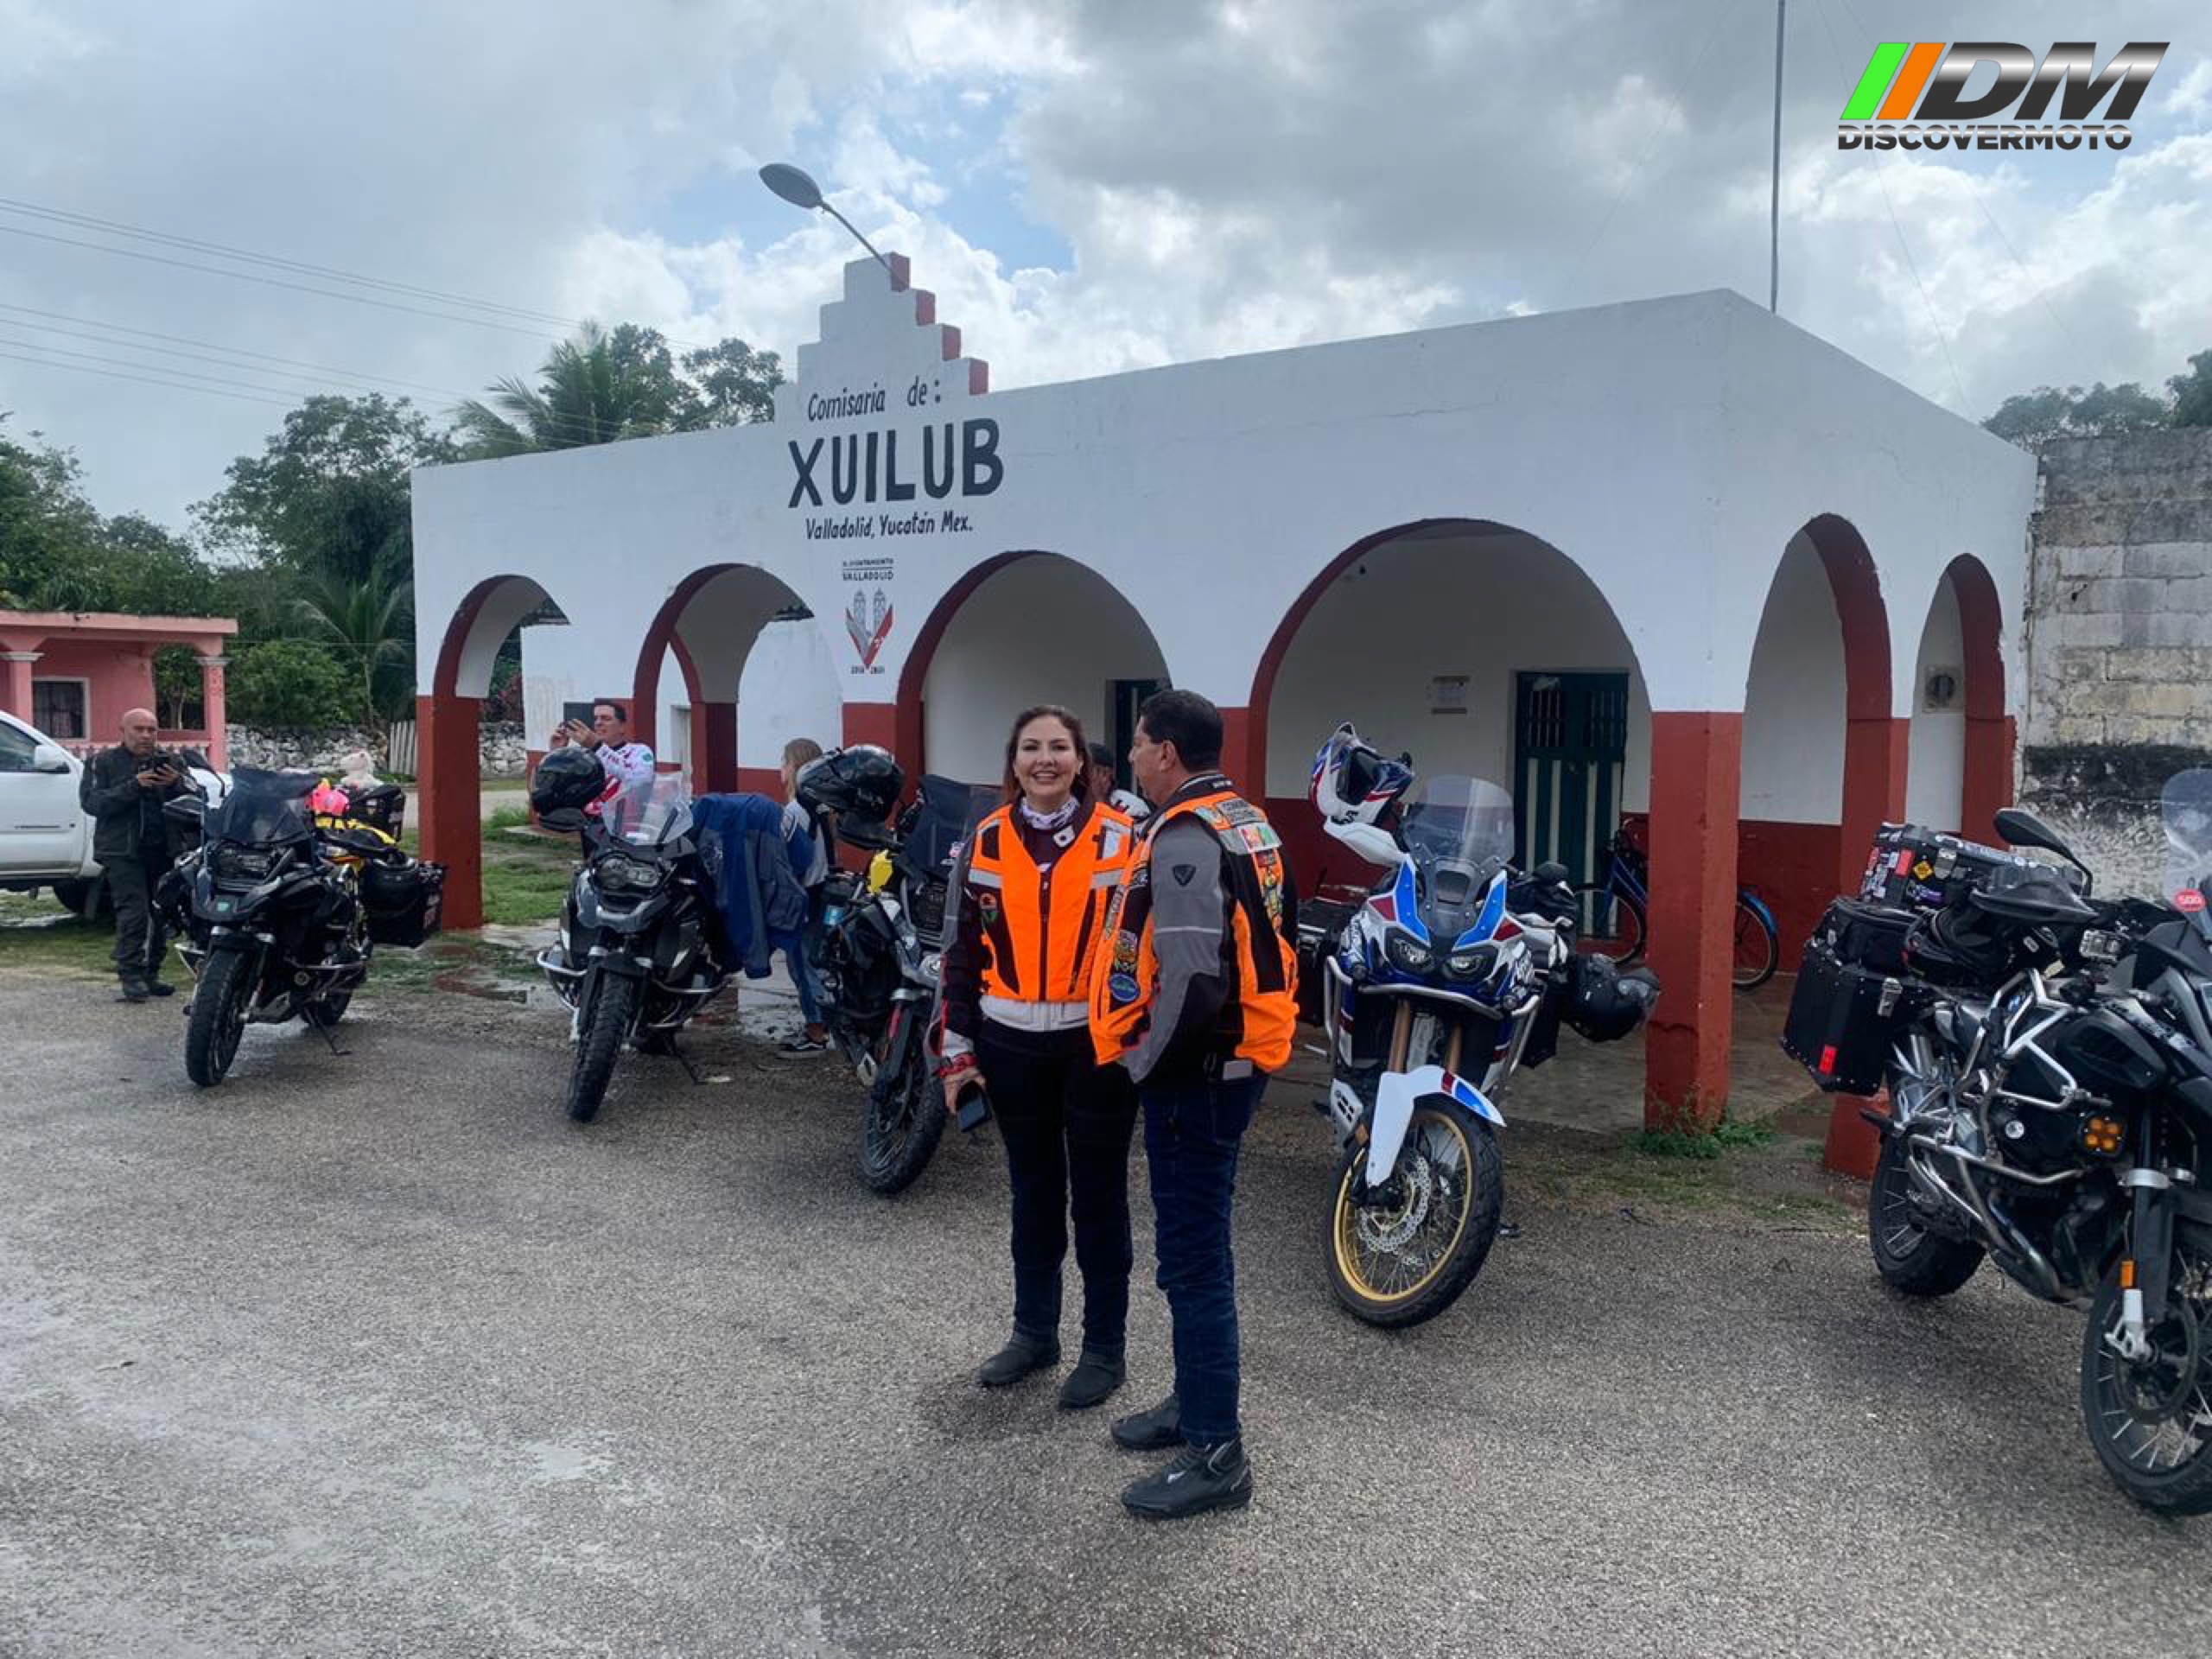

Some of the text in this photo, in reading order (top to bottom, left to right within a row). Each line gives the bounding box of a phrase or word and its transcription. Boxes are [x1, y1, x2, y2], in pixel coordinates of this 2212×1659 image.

[788, 417, 1004, 508] XUILUB
[806, 517, 874, 539] Valladolid,
[941, 510, 973, 532] Mex.
